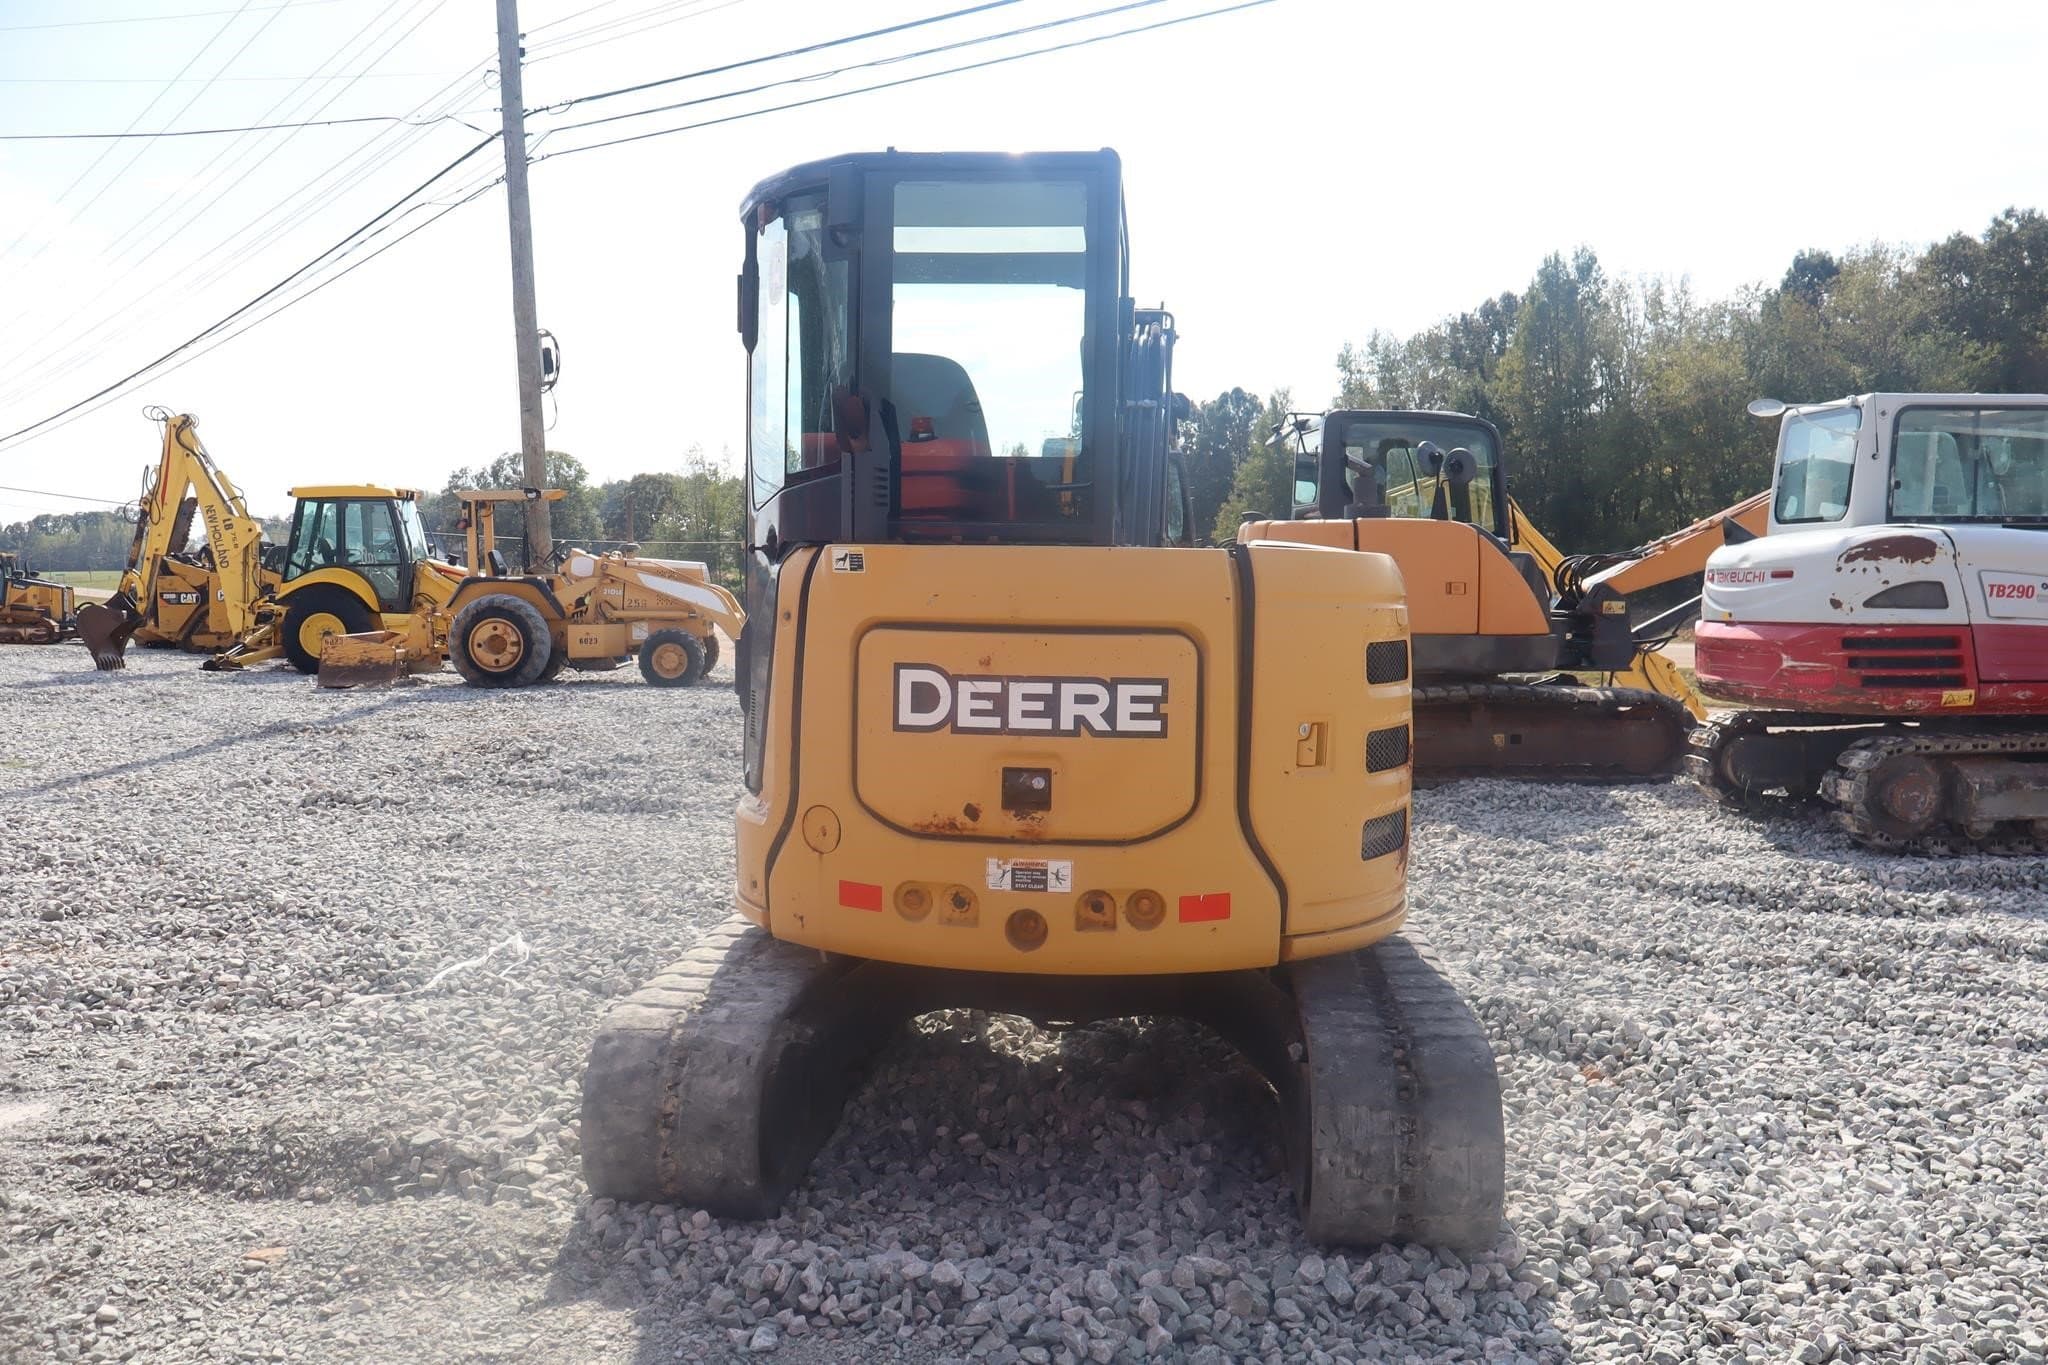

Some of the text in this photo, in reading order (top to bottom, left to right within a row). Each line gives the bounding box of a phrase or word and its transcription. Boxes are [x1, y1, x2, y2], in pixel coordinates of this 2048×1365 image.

[223, 518, 234, 531] LB
[205, 505, 230, 568] NEW HOLLAND
[180, 592, 197, 603] CAT
[1988, 584, 2035, 599] TB290
[898, 668, 1163, 732] DEERE
